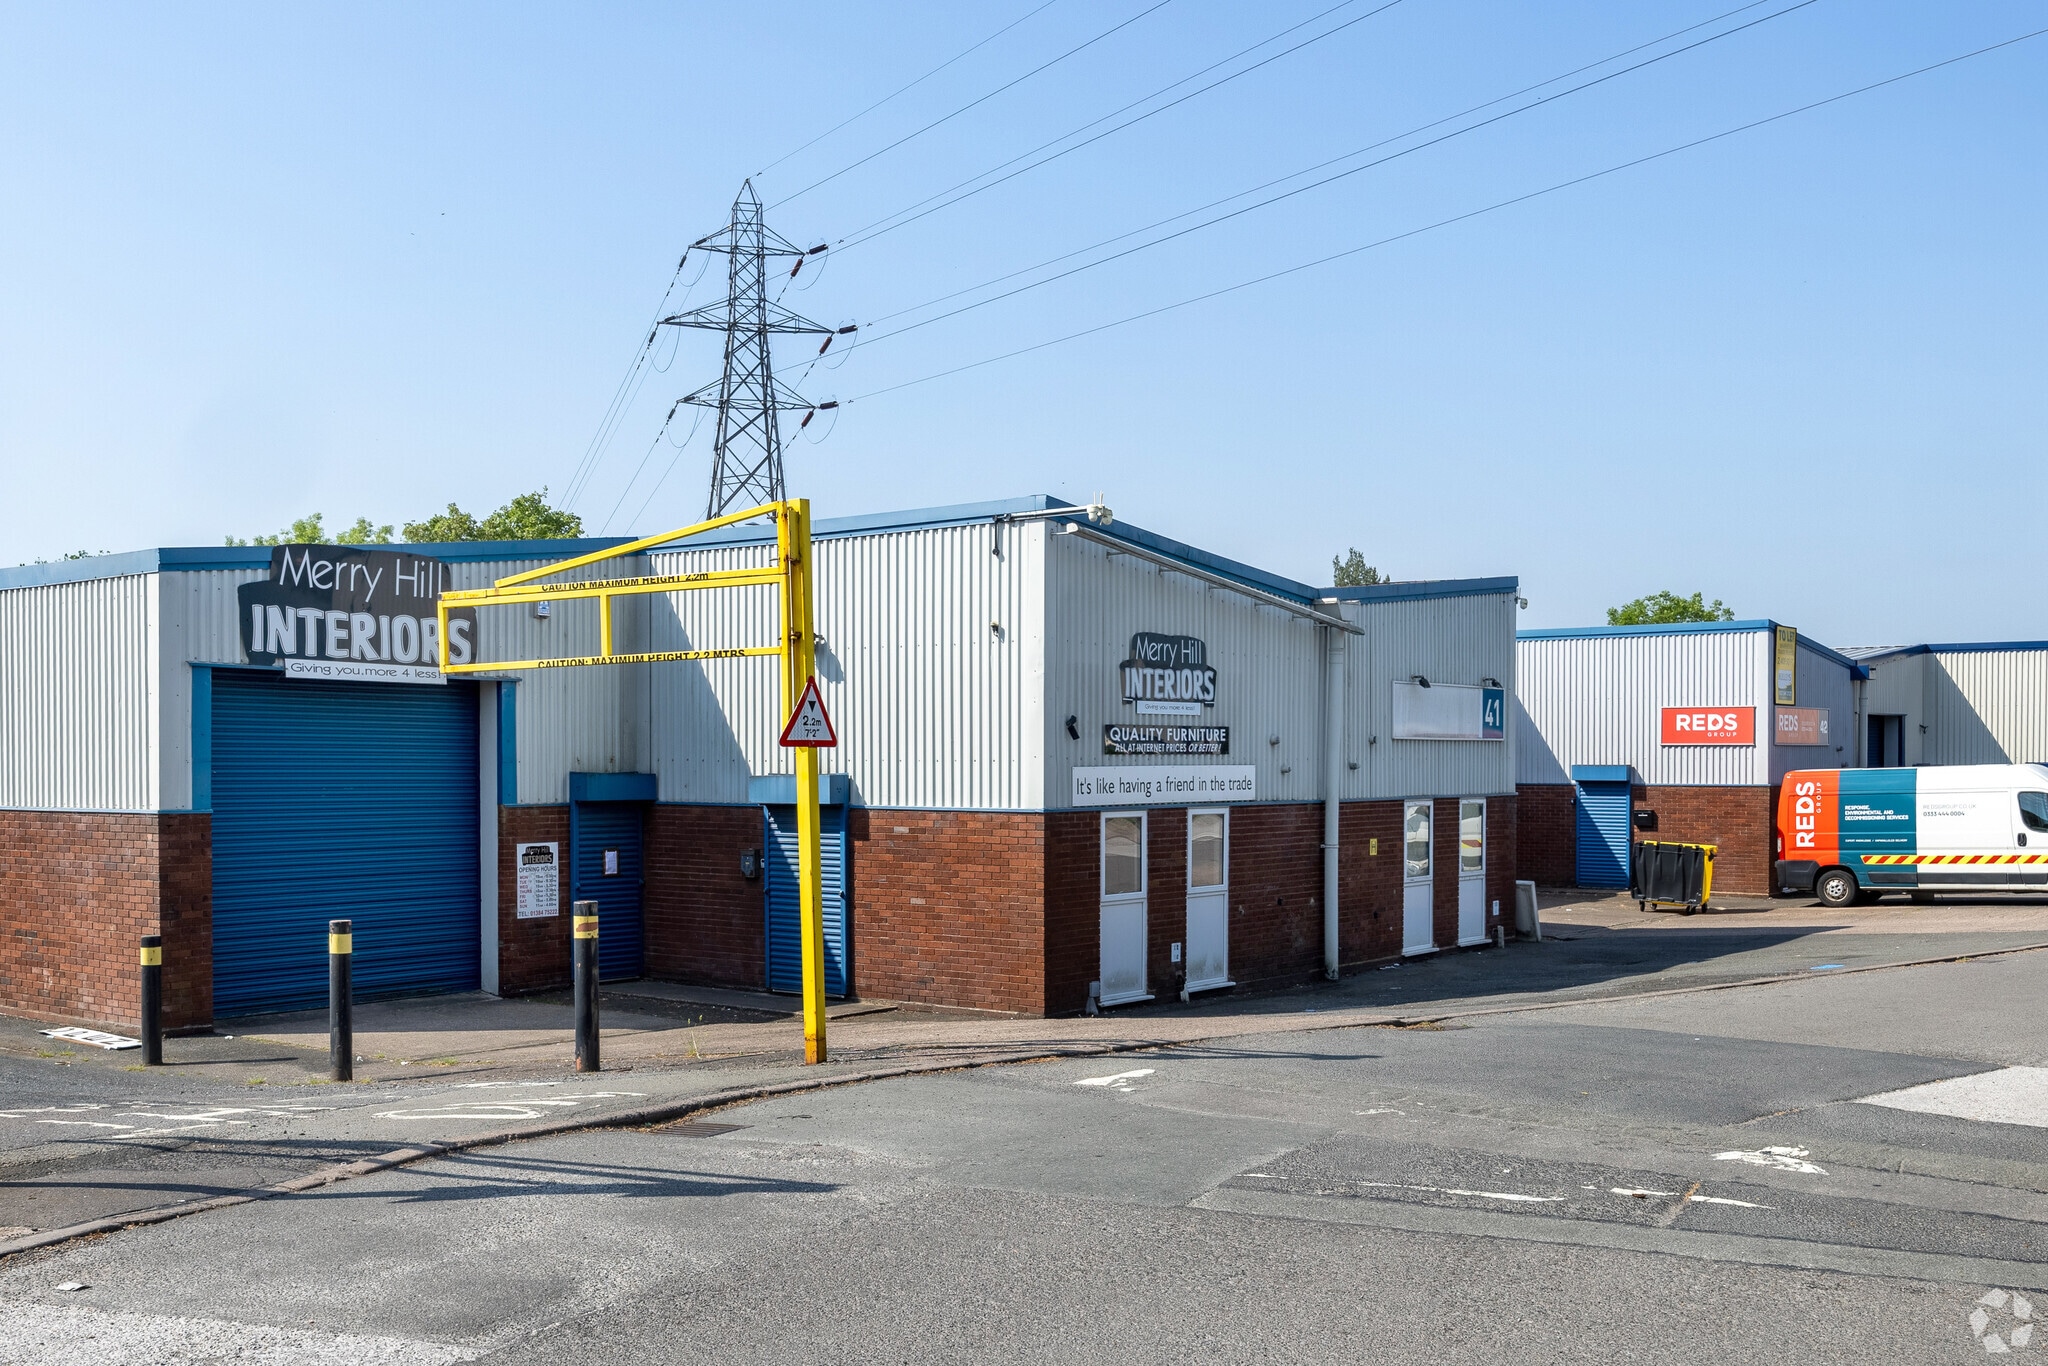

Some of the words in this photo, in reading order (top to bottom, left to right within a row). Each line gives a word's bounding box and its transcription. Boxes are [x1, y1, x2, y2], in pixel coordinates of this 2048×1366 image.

[279, 546, 383, 603] Merry
[395, 557, 443, 600] Hill
[541, 582, 586, 592] CAUTION
[589, 578, 639, 589] MAXIMUM
[642, 574, 681, 585] HEIGHT
[251, 603, 472, 665] INTERIORS
[1778, 629, 1787, 641] TO
[591, 654, 644, 665] MAXIMUM
[648, 652, 690, 662] HEIGHT
[693, 651, 710, 660] 22
[713, 649, 746, 658] MTRS
[1135, 635, 1178, 667] Merry
[1181, 639, 1202, 665] Hill
[290, 662, 332, 676] Giving
[401, 668, 410, 677] 4
[1125, 666, 1215, 701] INTERIORS
[1145, 703, 1158, 711] Giving
[1484, 699, 1500, 727] 41
[802, 715, 822, 727] 2.2m
[1676, 713, 1738, 731] REDS
[1778, 714, 1799, 731] REDS
[1820, 720, 1828, 734] 42
[1109, 726, 1164, 742] QUALITY
[1167, 727, 1227, 742] FURNITURE
[1115, 743, 1126, 752] ALL
[1127, 743, 1136, 752] AT
[1136, 743, 1164, 752] INTERNET
[1166, 743, 1187, 752] PRICES
[1188, 743, 1198, 752] OR
[1198, 743, 1222, 752] BETTER!
[1076, 777, 1092, 795] It's
[1096, 777, 1115, 794] like
[1119, 776, 1152, 798] having
[1156, 781, 1162, 792] a
[1165, 775, 1195, 792] friend
[1198, 776, 1207, 791] in
[1210, 775, 1226, 791] the
[1228, 774, 1252, 791] trade
[1795, 781, 1815, 848] REDS
[522, 854, 553, 864] INTERIORS
